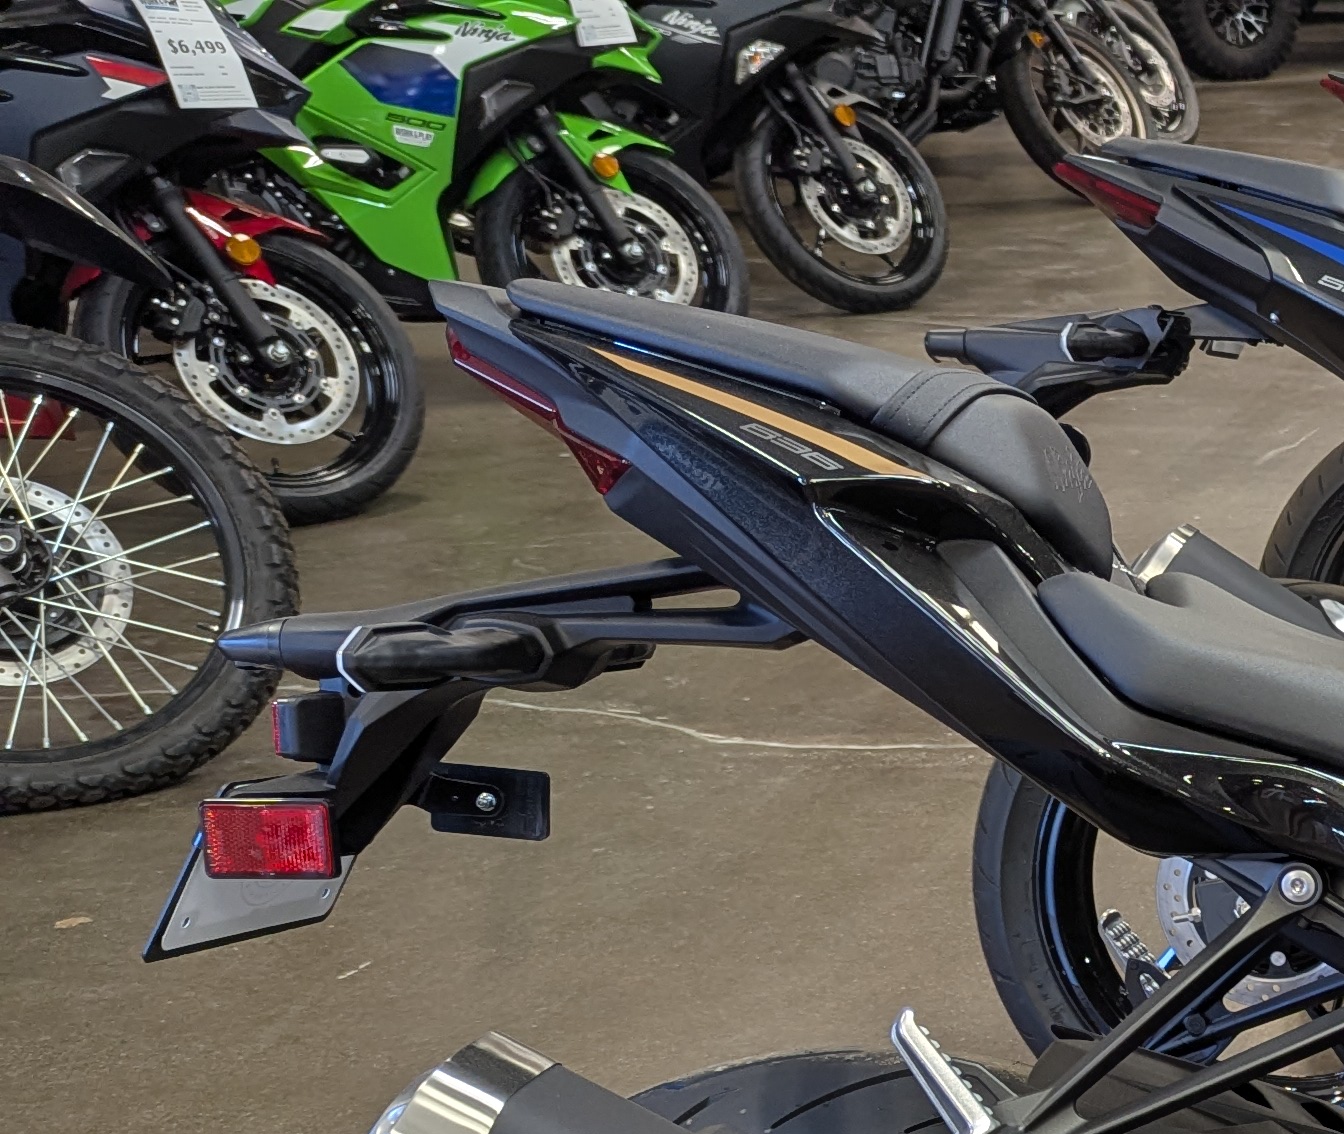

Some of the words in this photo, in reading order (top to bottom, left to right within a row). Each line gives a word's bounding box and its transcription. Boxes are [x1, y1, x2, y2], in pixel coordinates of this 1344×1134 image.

[454, 20, 516, 44] Ninja
[661, 10, 720, 37] Ninja
[167, 38, 227, 56] $6,499
[739, 422, 845, 471] 636
